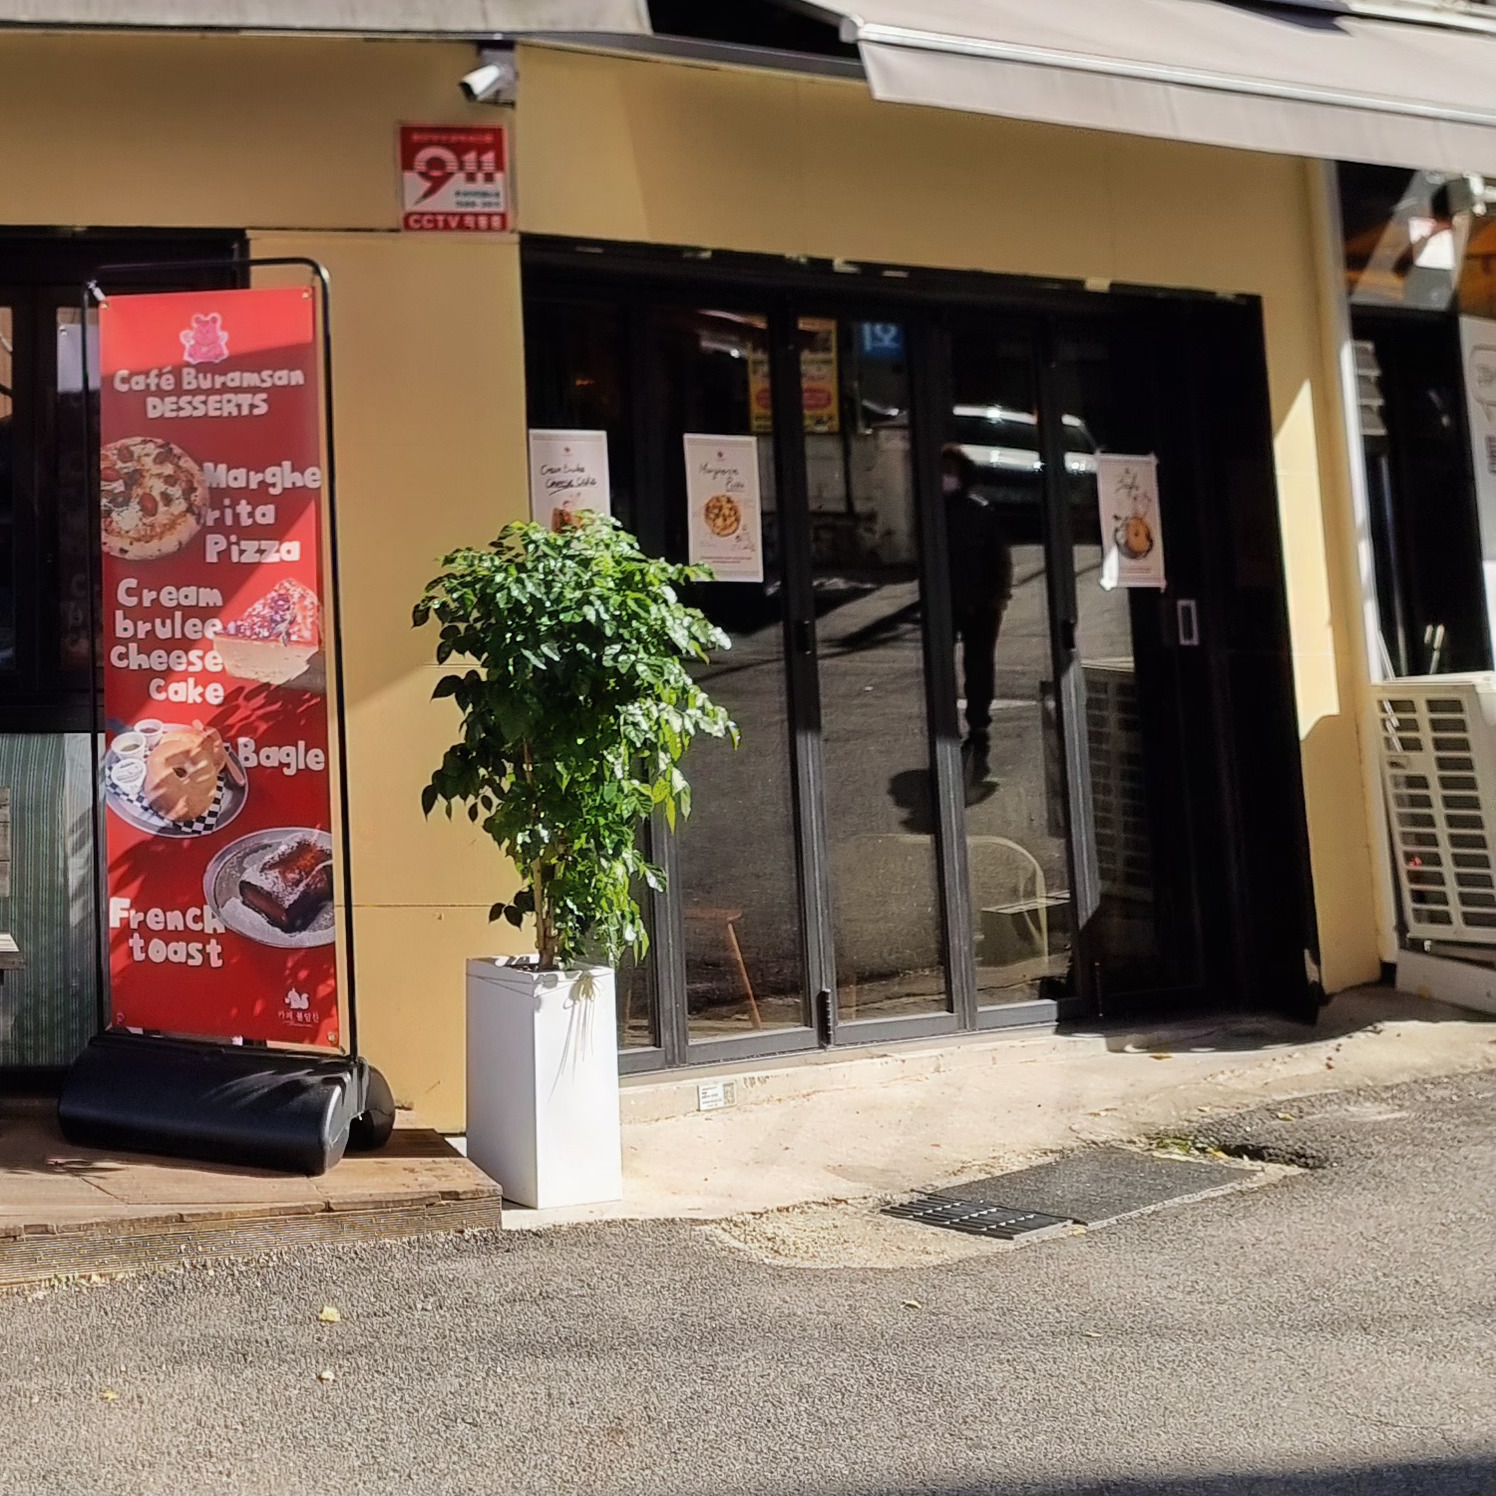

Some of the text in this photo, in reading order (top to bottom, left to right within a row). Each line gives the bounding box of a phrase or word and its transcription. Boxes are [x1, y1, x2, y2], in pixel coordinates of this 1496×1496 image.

[413, 146, 496, 205] 911
[408, 213, 460, 228] CCTV
[112, 365, 305, 392] Café Buramsan
[145, 393, 269, 418] DESSERTS
[203, 461, 322, 495] Marghe
[204, 498, 276, 527] rita
[204, 534, 302, 564] Pizza
[116, 577, 224, 608] Cream
[114, 610, 225, 640] brulee
[236, 737, 326, 776] Bagle
[108, 896, 227, 934] French
[128, 932, 224, 969] toast
